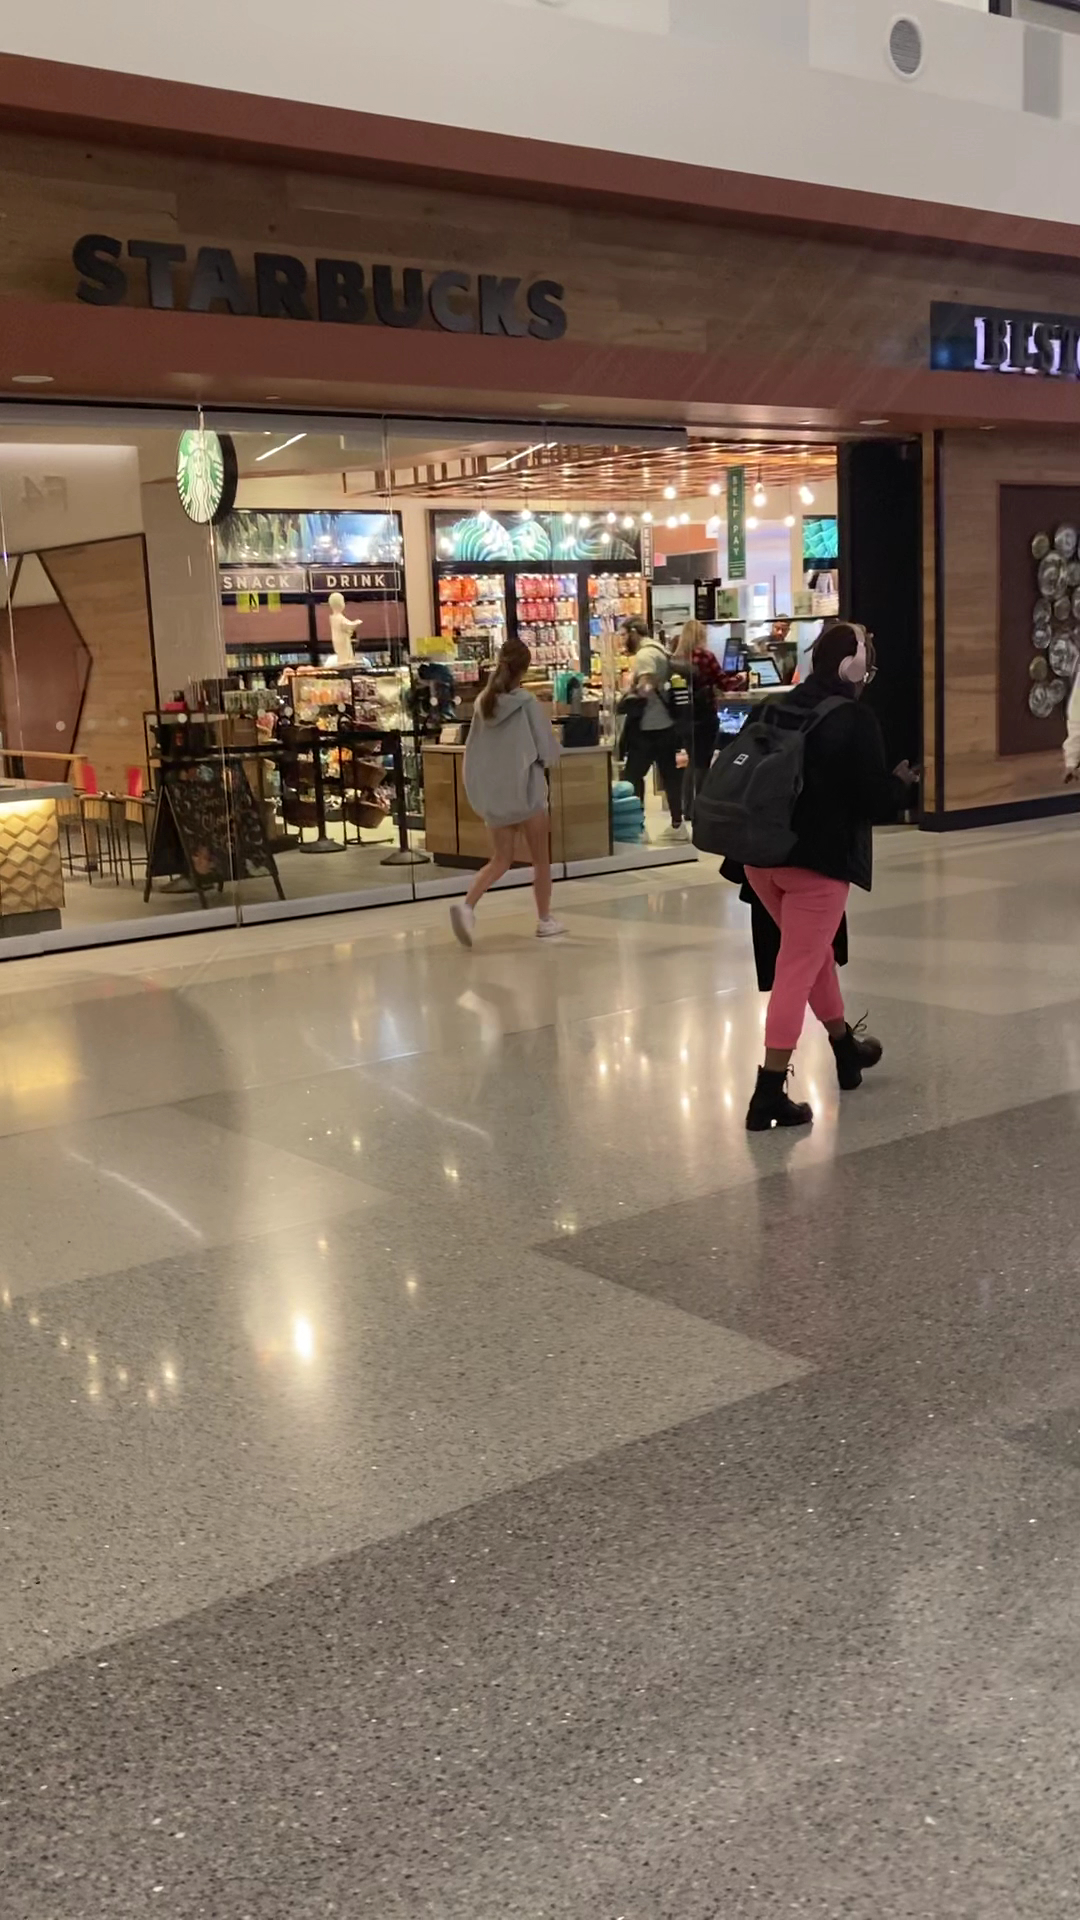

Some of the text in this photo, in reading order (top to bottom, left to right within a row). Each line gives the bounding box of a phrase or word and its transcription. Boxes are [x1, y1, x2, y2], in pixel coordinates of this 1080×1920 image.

[72, 233, 568, 341] STARBUCKS
[732, 475, 740, 556] SELF PAY
[223, 574, 291, 589] SNACK
[326, 573, 386, 588] DRINK
